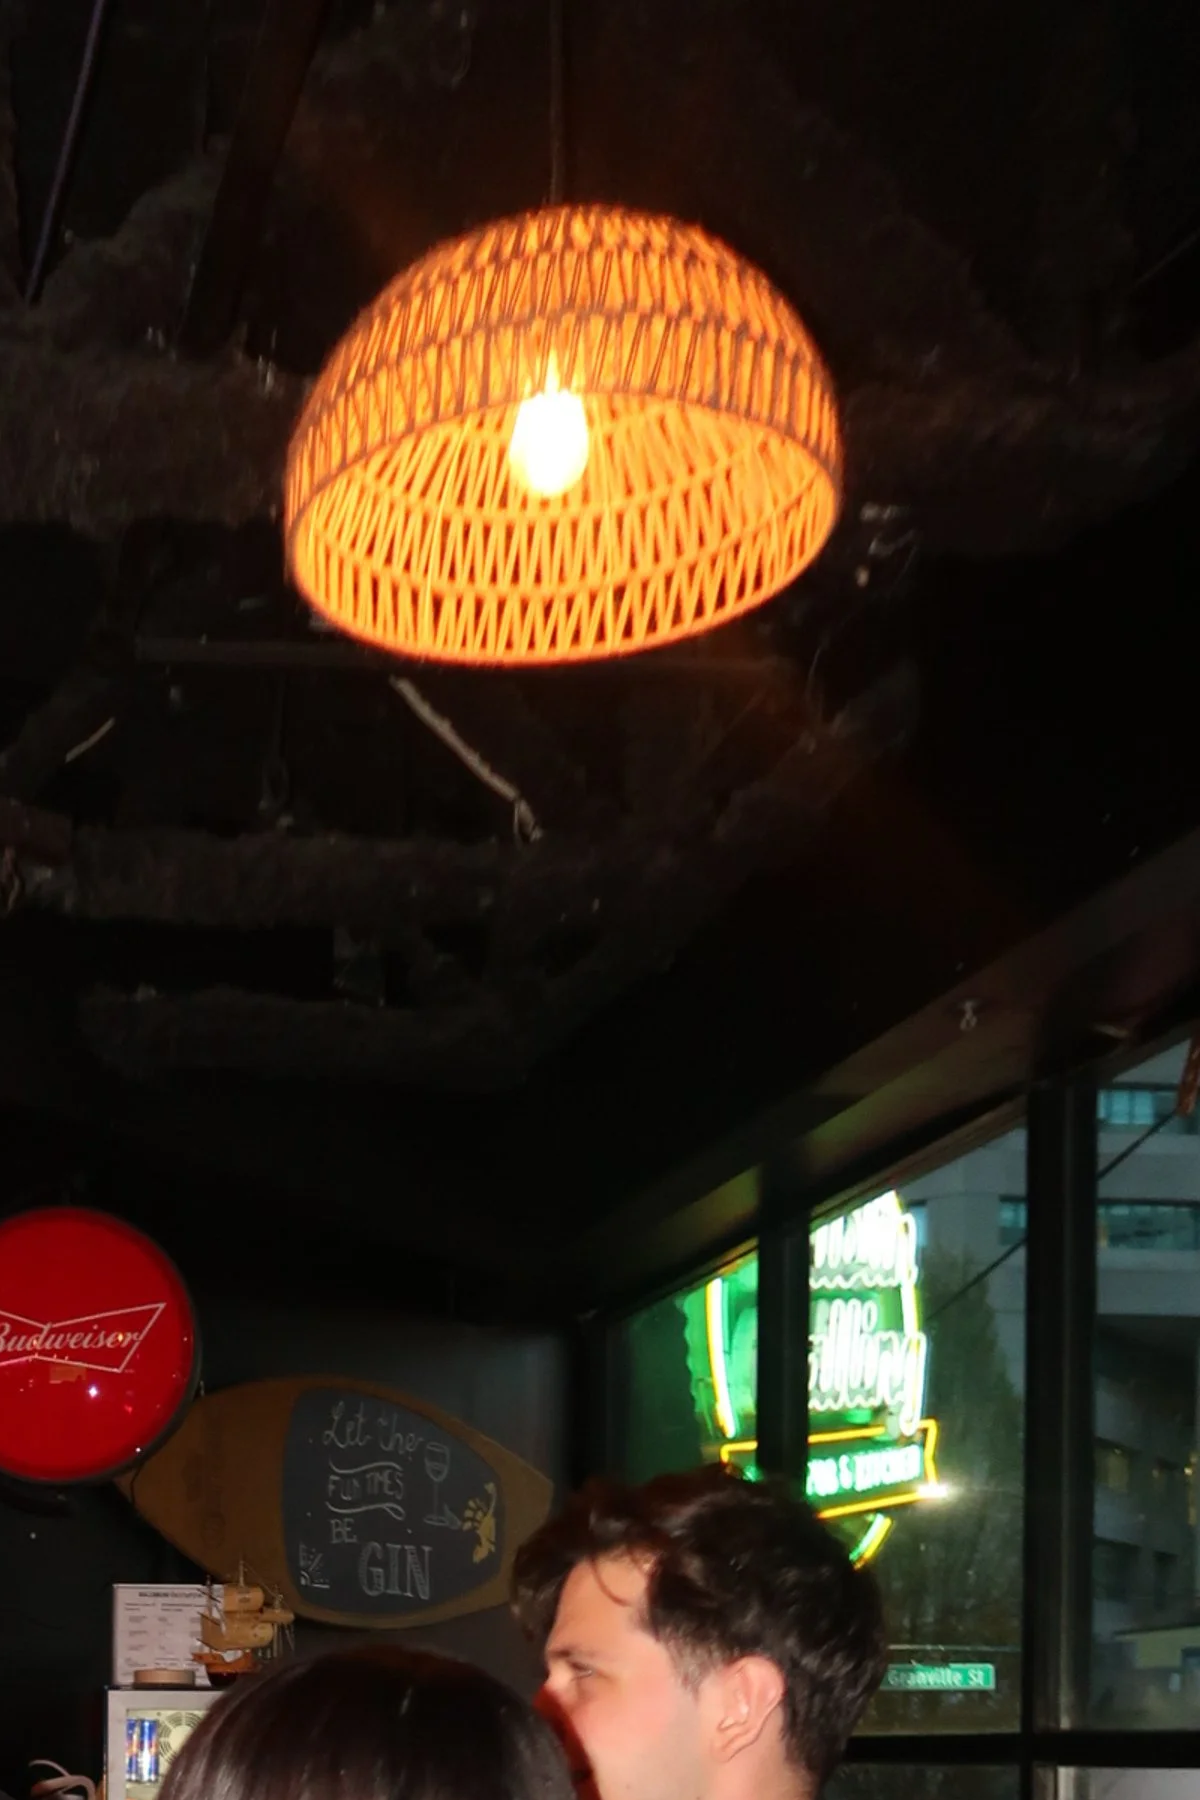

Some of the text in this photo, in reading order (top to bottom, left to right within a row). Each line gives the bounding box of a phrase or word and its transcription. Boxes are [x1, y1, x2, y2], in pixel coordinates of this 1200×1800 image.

[322, 1400, 374, 1450] Let
[329, 1517, 358, 1544] BE
[357, 1541, 434, 1600] GIN
[888, 1666, 985, 1687] Granville St
